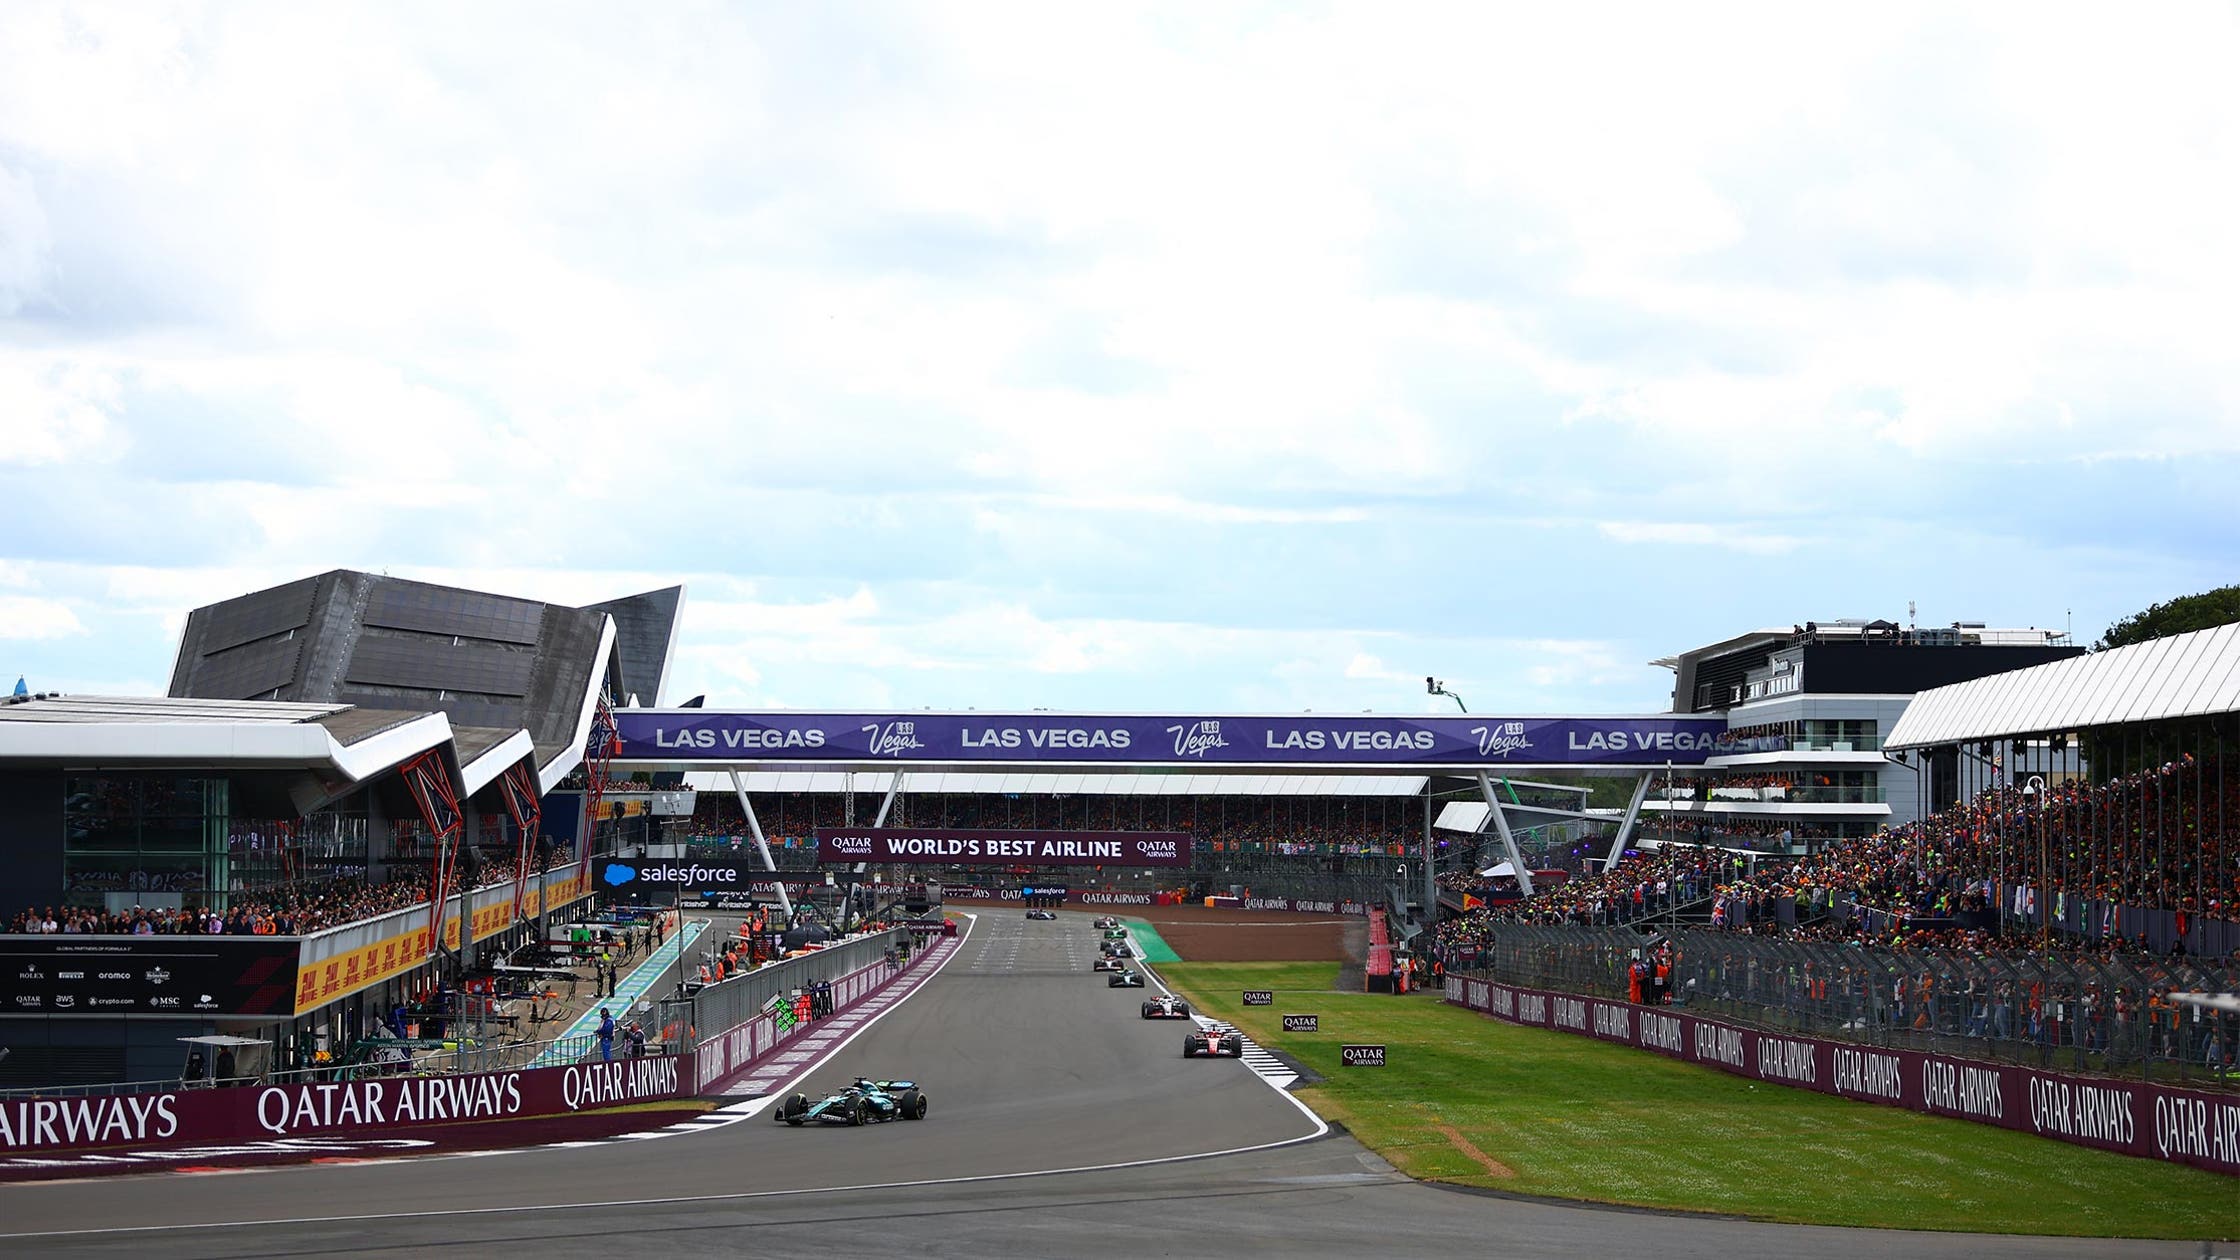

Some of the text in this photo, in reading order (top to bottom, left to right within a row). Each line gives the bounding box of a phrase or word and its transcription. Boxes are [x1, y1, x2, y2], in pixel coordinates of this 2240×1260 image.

[896, 722, 914, 734] LAS
[1200, 721, 1220, 734] LAS
[1505, 722, 1524, 734] LAS
[656, 728, 826, 748] LAS VEGAS
[862, 723, 924, 756] Vegas
[962, 728, 1130, 748] LAS VEGAS
[1166, 724, 1229, 757] Vegas
[1266, 730, 1434, 750] LAS VEGAS
[1471, 725, 1534, 758] Vegas
[1569, 732, 1628, 750] LAS
[832, 838, 872, 848] QATAR
[887, 838, 1122, 858] WORLD'S BEST AIRLINE
[1136, 841, 1176, 852] QATAR
[641, 864, 737, 886] salesforce
[1000, 890, 1022, 900] QATA
[1082, 892, 1151, 904] QATAR AIRWAYS
[1244, 898, 1288, 910] QATAR AIRWAYS
[1296, 900, 1314, 912] QATAR
[20, 972, 44, 980] ROLEX
[56, 995, 74, 1003] aws
[1244, 992, 1271, 1001] QATAR
[1284, 1018, 1316, 1026] QATAR
[1640, 1010, 1658, 1046] QATAR
[1344, 1048, 1384, 1060] QATAR
[1695, 1022, 1744, 1068] QATAR AIRWAYS
[1758, 1037, 1816, 1083] QATAR AIRWAYS
[564, 1062, 624, 1110] QATAR
[628, 1056, 678, 1099] AIRWAYS
[1834, 1048, 1901, 1099] QATAR AIRWAYS
[1923, 1059, 2003, 1119] QATAR AIRWAYS
[258, 1073, 521, 1134] QATAR AIRWAYS
[2030, 1076, 2134, 1144] QATAR AIRWAYS
[2156, 1096, 2210, 1158] QATAR
